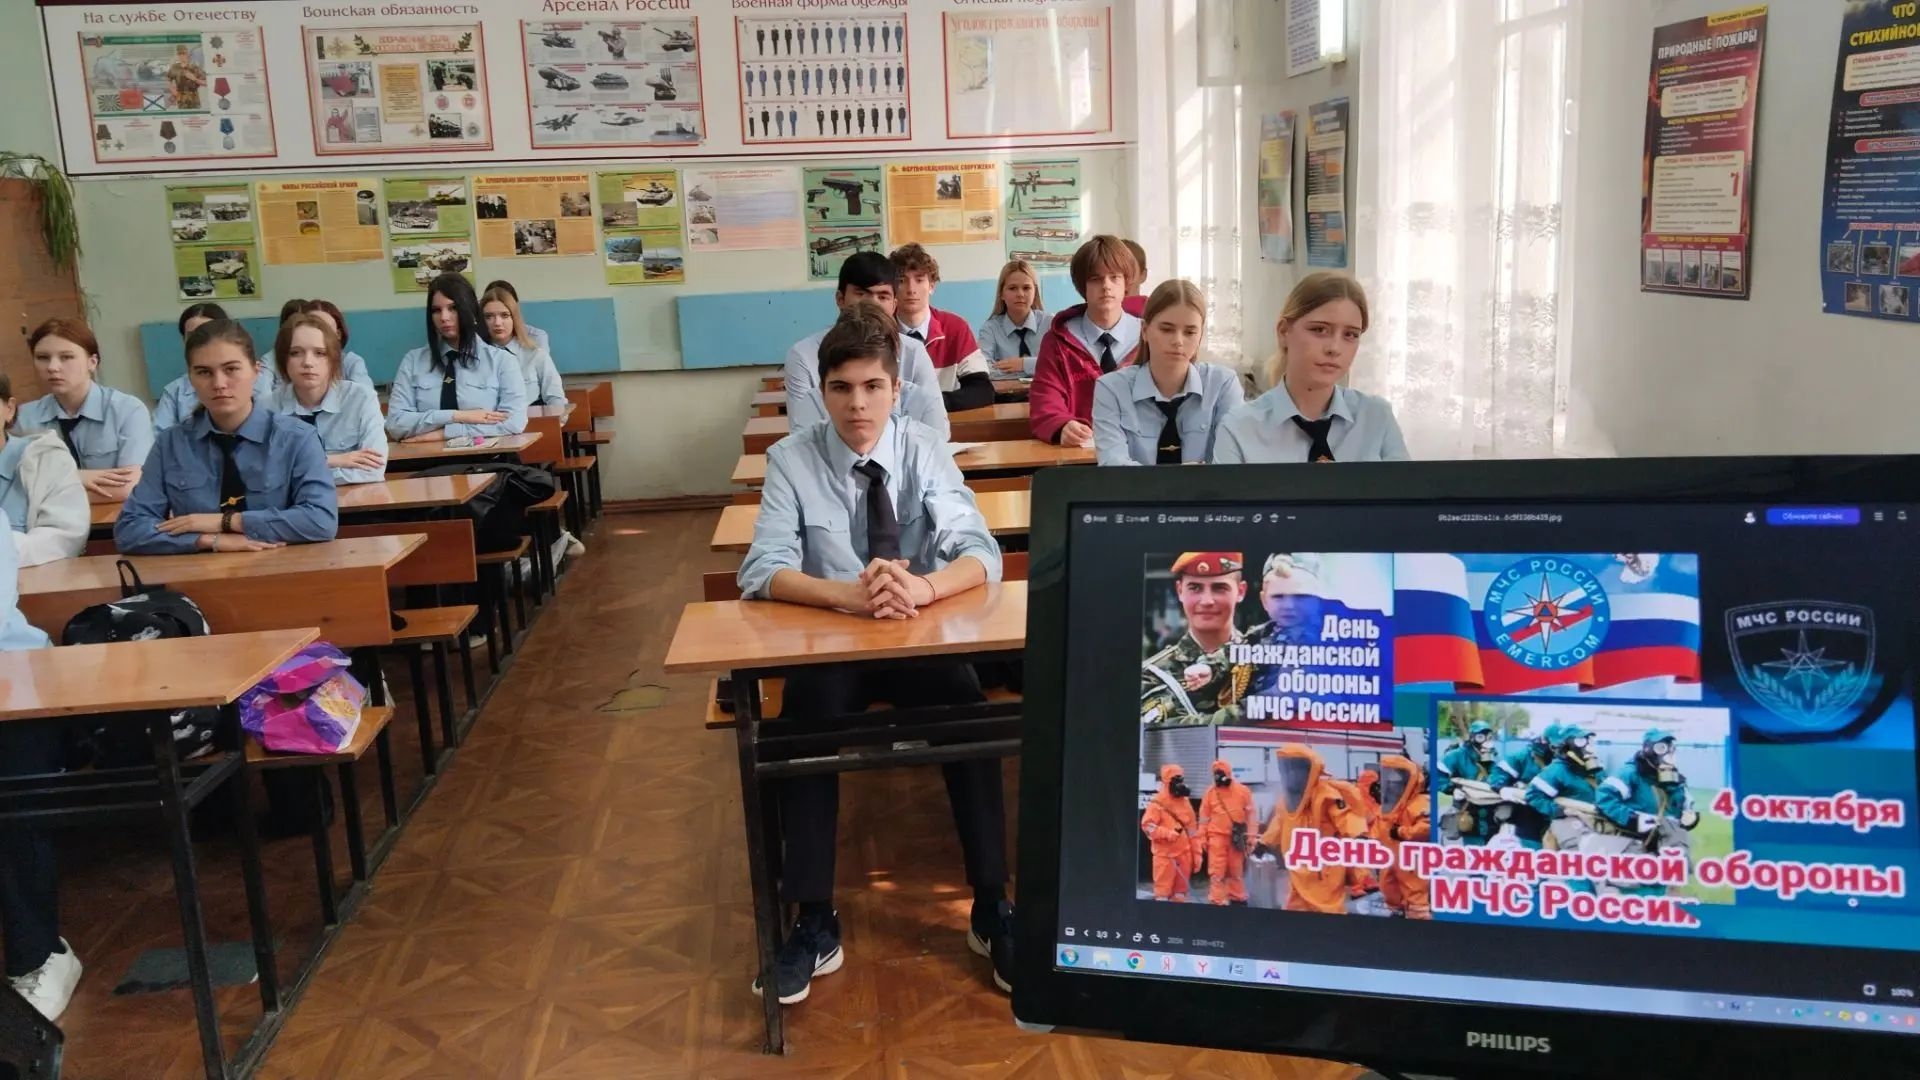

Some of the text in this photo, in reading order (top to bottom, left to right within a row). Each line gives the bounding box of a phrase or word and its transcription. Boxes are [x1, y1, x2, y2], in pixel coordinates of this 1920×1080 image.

[83, 9, 257, 26] На службе Отечеству
[303, 4, 479, 18] Воинская обязанность
[542, 0, 690, 15] Арсенал России
[732, 0, 793, 9] Военная
[797, 0, 848, 10] форма
[1892, 2, 1916, 18] ЧТО
[1657, 28, 1758, 60] ПРИРОДНЫЕ ПОЖАРЫ
[1488, 559, 1606, 606] МЧС РОССИИ
[1320, 614, 1380, 642] День
[1736, 609, 1862, 629] МЧС РОССИИ
[1228, 641, 1380, 668] гражданской
[1495, 632, 1602, 669] EMERCOM
[1277, 668, 1380, 696] обороны
[1246, 694, 1380, 724] МЧС России
[1711, 790, 1904, 831] 4 октября
[1287, 829, 1902, 897] День гражданской обороны
[1433, 878, 1532, 914] МЧС
[1466, 1031, 1552, 1053] PHILIPS
